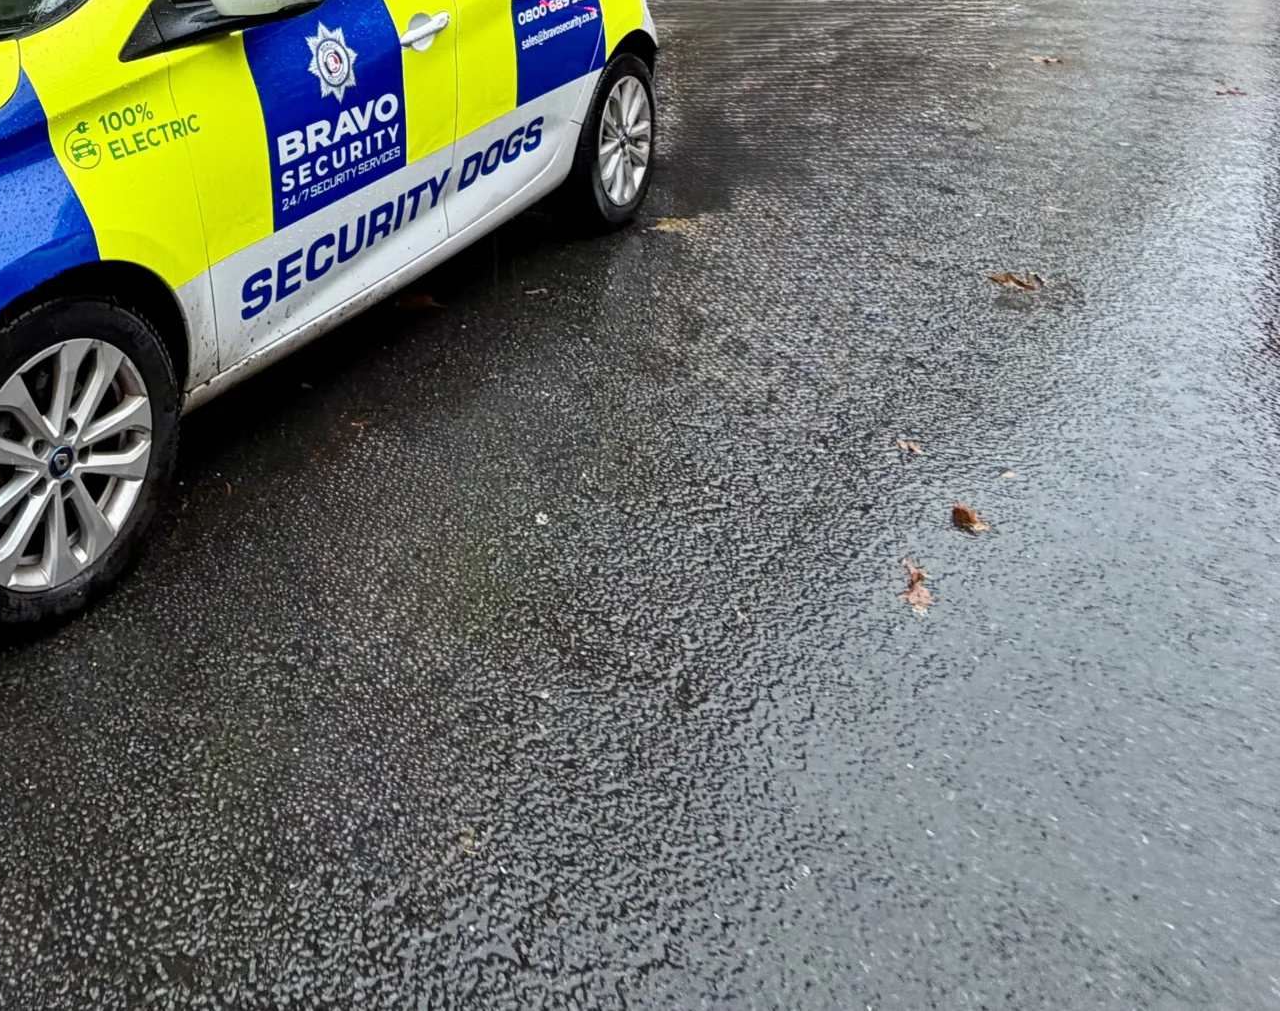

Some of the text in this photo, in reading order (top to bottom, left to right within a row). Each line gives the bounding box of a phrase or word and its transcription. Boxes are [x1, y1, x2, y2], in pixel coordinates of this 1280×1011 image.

[517, 4, 547, 25] 0800
[521, 10, 598, 50] sales@bravosecurity.co.uk
[98, 102, 154, 134] 100%
[107, 114, 200, 160] ELECTRIC
[277, 93, 399, 166] BRAVO
[281, 123, 400, 192] SECURITY
[282, 146, 401, 211] 24/7 SECURITY SERVICES
[241, 116, 544, 320] SECURITY DOGS
